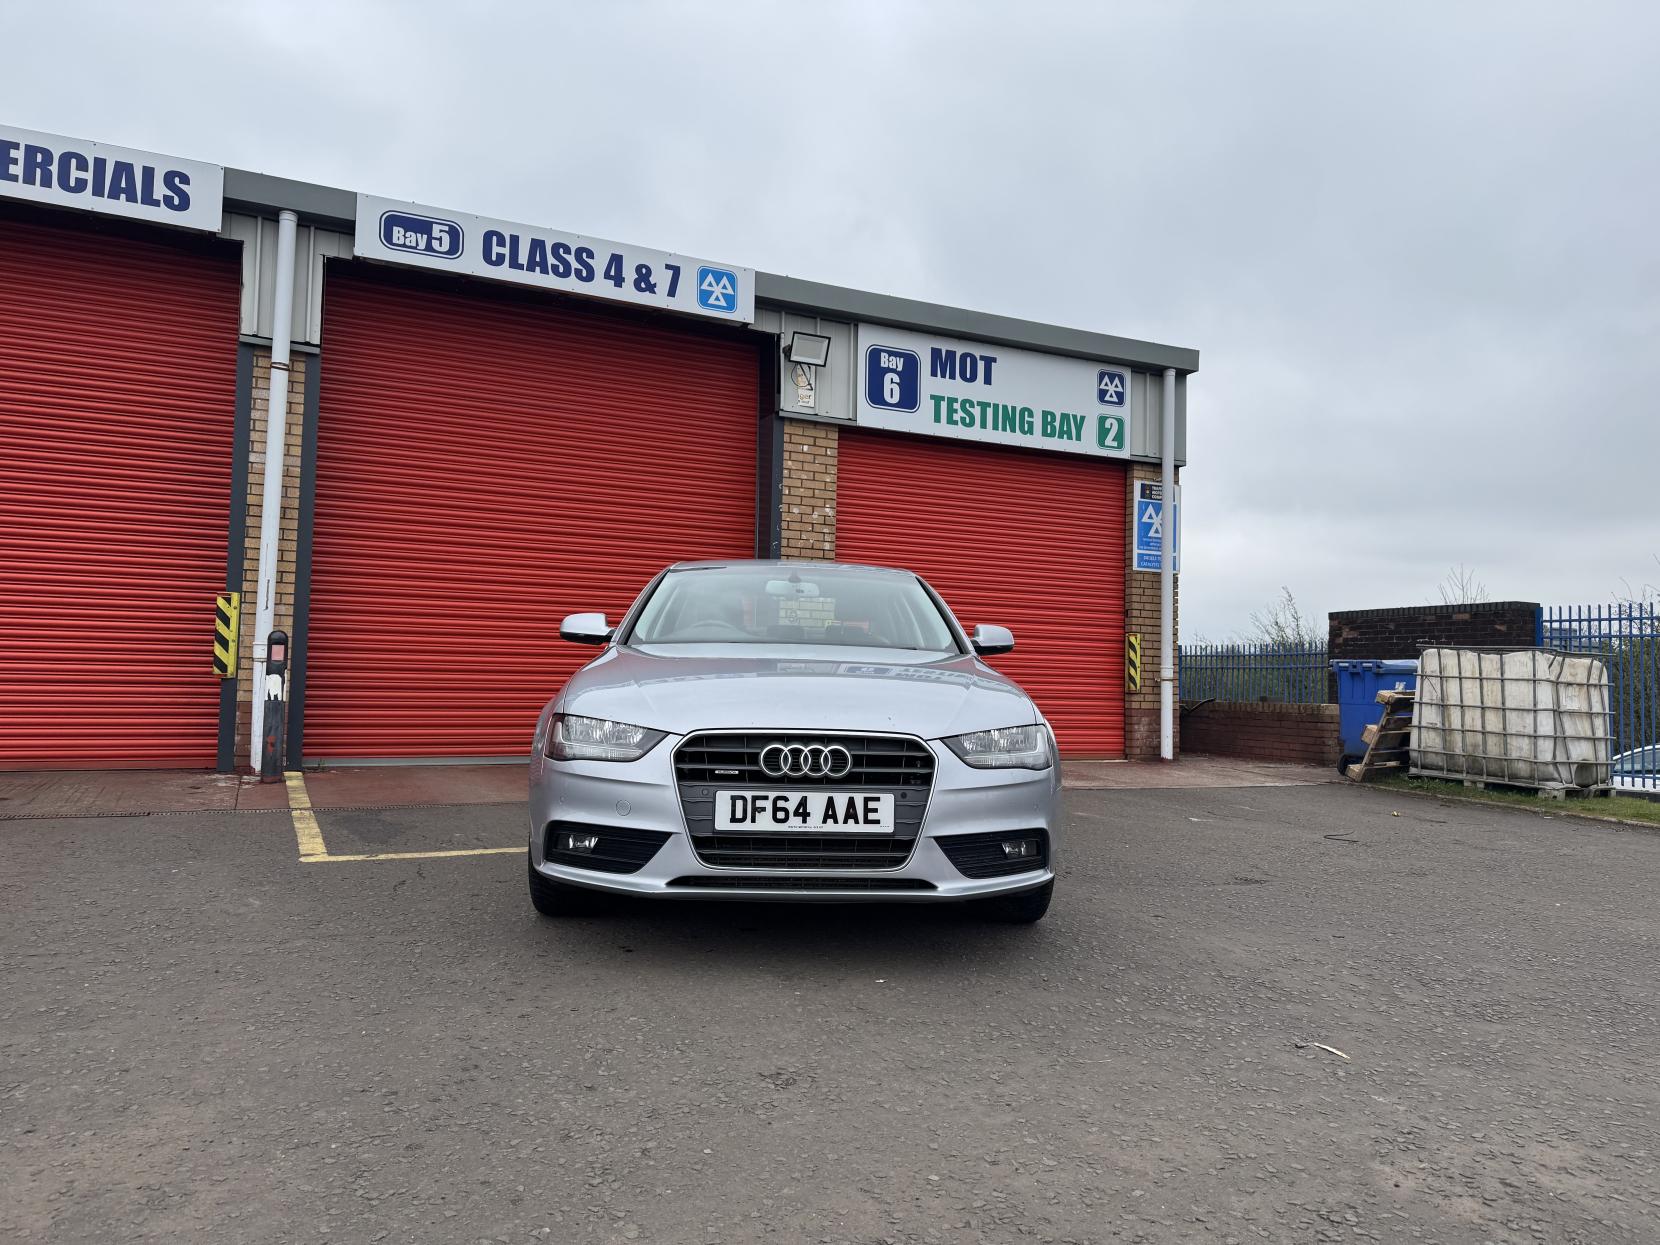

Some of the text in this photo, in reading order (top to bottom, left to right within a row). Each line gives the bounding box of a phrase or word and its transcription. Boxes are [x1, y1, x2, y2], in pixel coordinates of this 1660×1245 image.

[392, 223, 451, 252] Bay 5
[482, 230, 681, 298] CLASS 4 & 7
[880, 351, 904, 372] Bay
[930, 346, 997, 386] MOT
[883, 372, 901, 404] 6
[930, 394, 1118, 447] TESTING BAY 2
[729, 795, 881, 825] DF64 AAE
